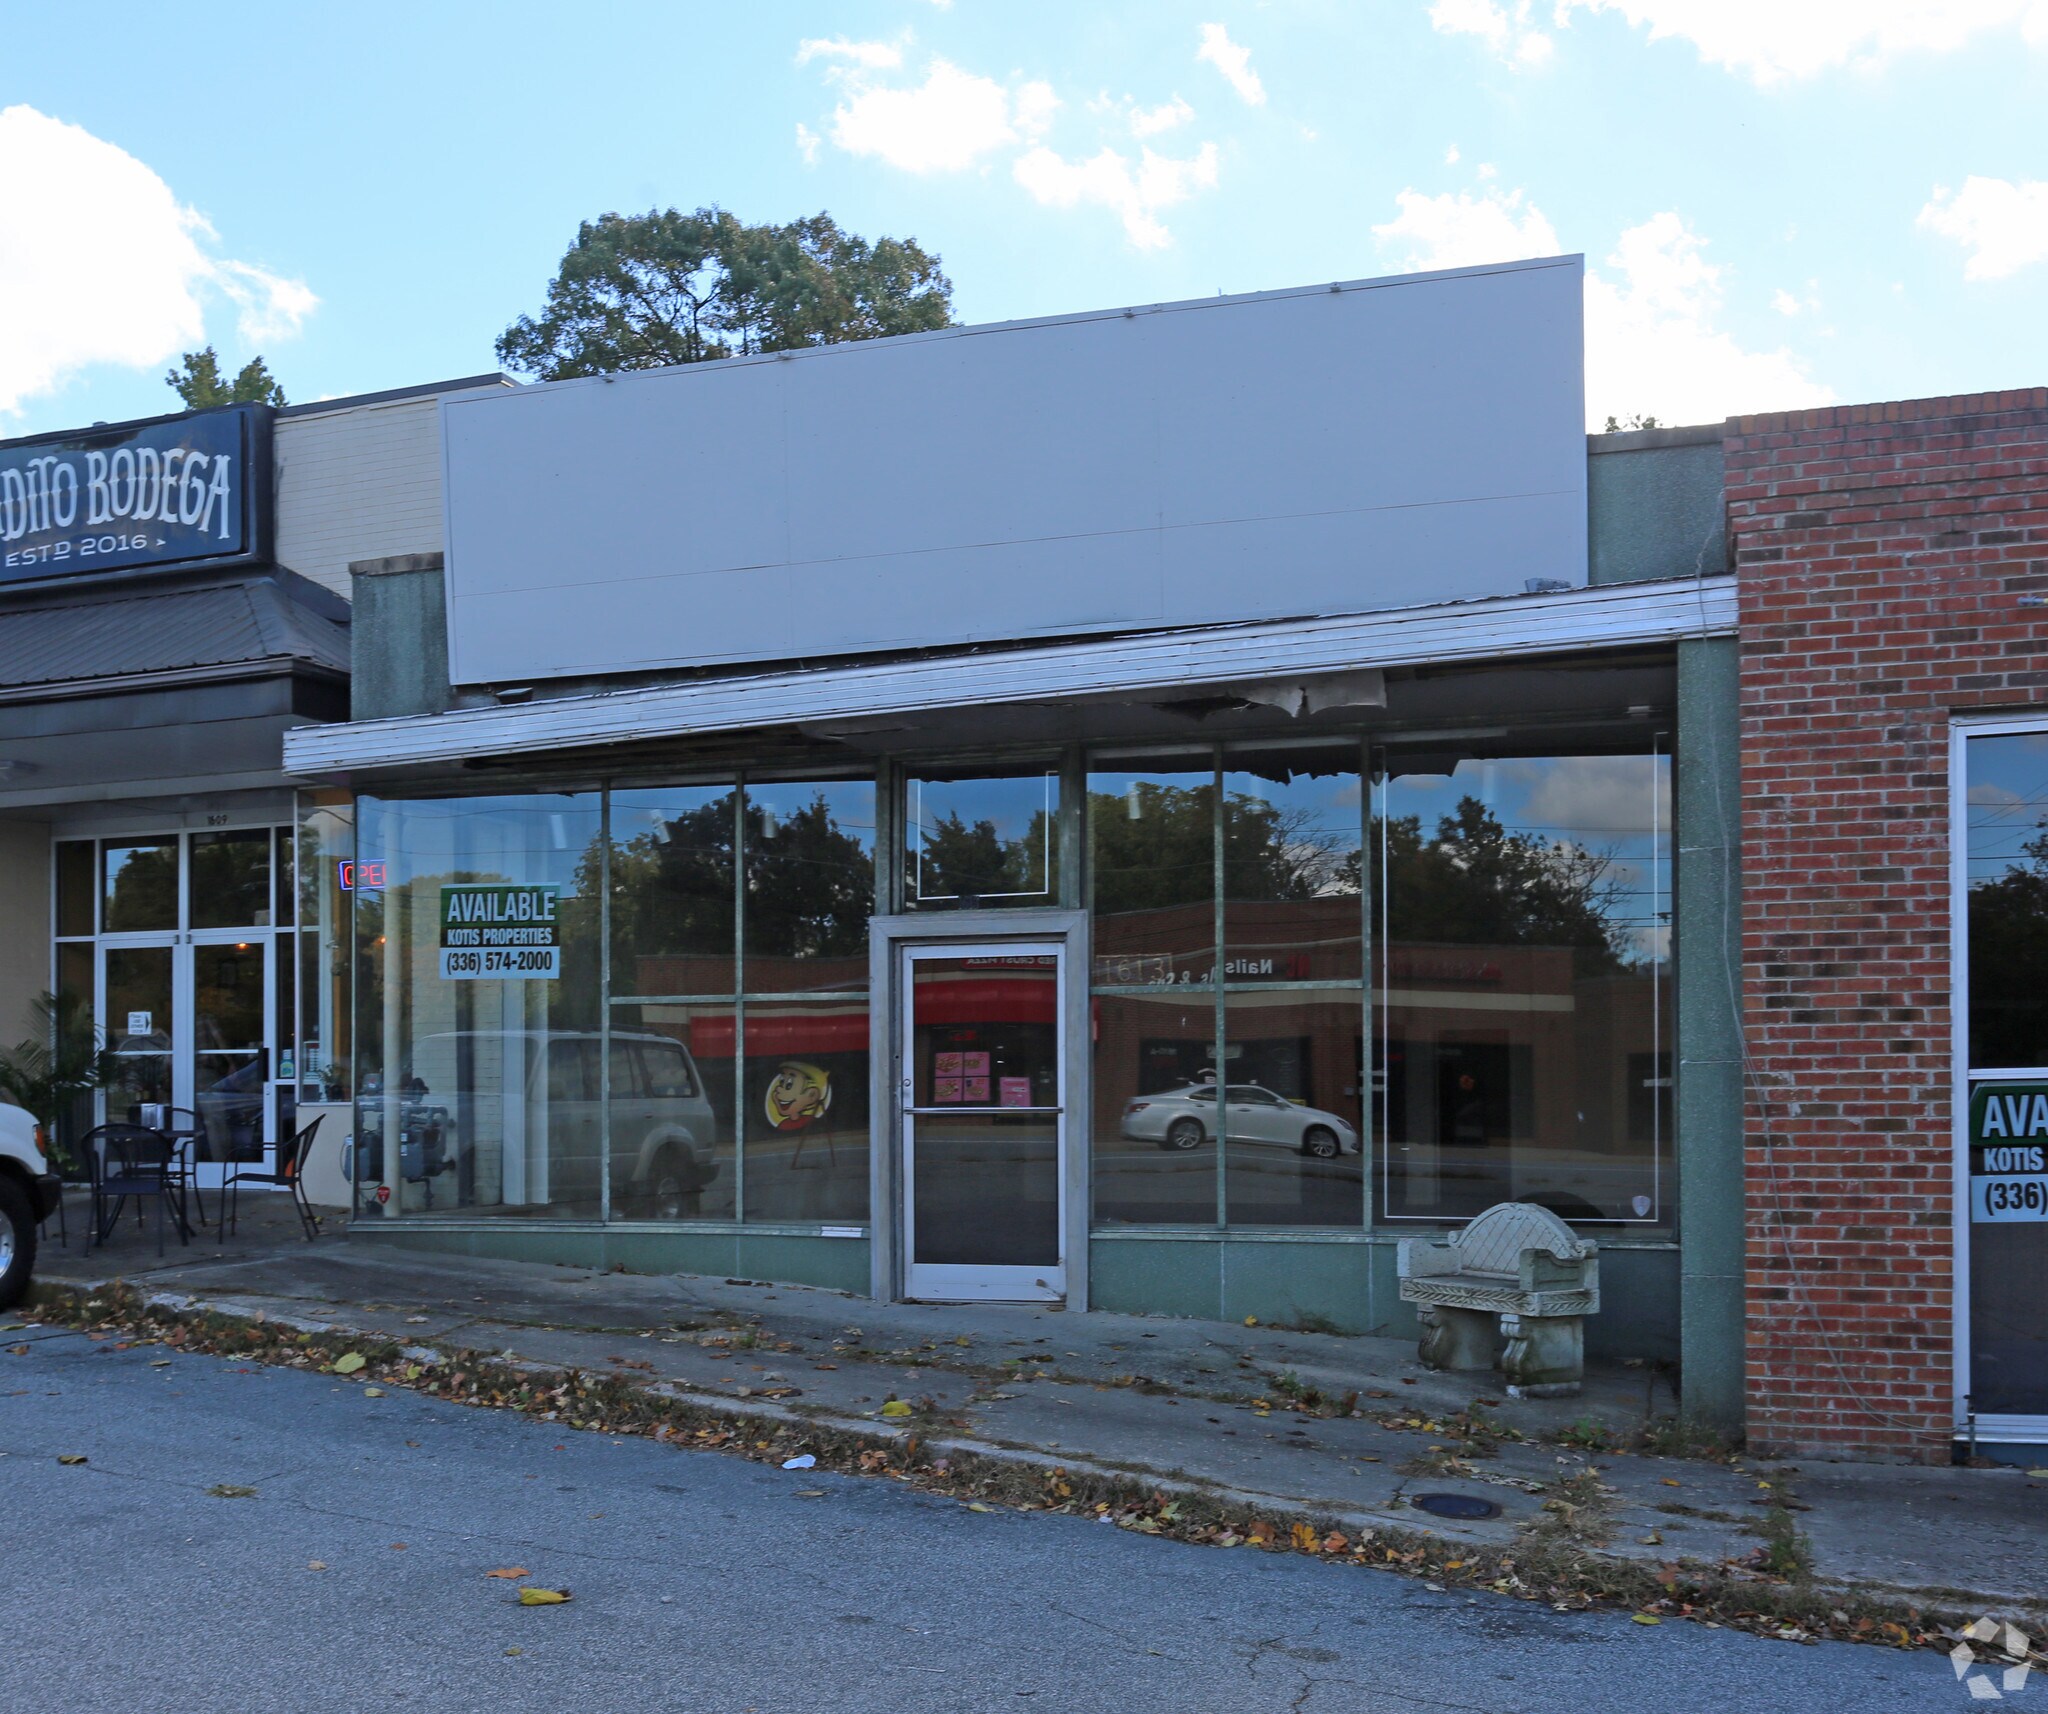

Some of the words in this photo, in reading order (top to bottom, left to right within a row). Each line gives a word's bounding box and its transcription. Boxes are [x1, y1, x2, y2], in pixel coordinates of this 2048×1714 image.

[0, 456, 78, 542] DITO
[85, 447, 231, 539] BODEGA
[5, 541, 71, 567] ESTD
[80, 534, 147, 556] 2016
[447, 891, 556, 922] AVAILABLE
[447, 928, 480, 945] KOTIS
[483, 927, 552, 945] PROPERTIES
[447, 952, 481, 975] (336)
[486, 951, 552, 971] 574-2000
[1104, 957, 1165, 982] 1613
[1981, 1094, 2048, 1138] AVA
[1983, 1146, 2044, 1172] KOTIS
[1985, 1181, 2048, 1216] (336)
